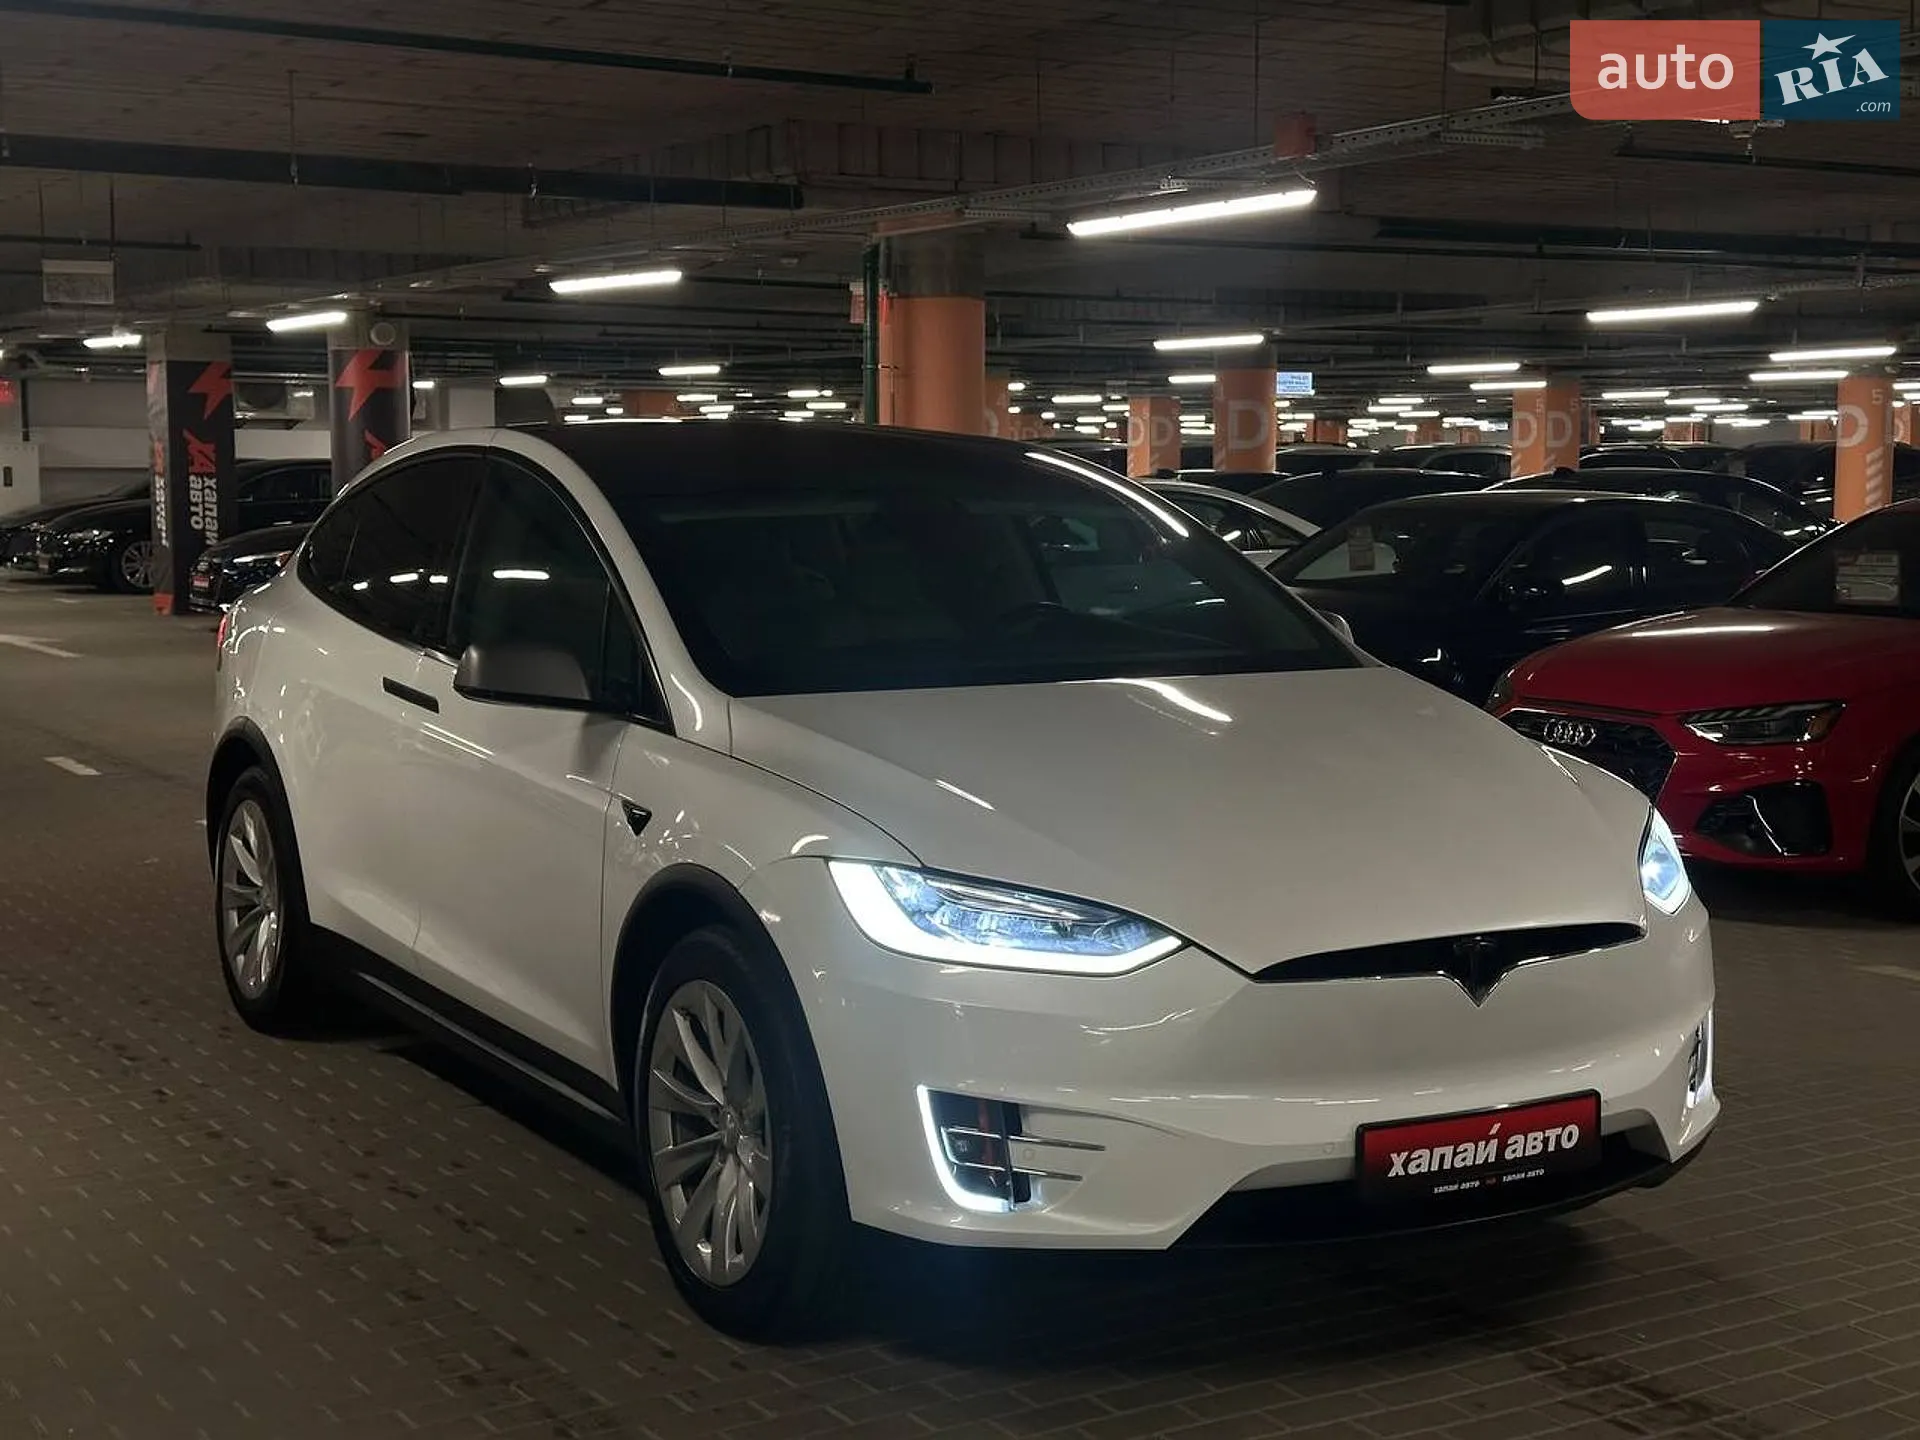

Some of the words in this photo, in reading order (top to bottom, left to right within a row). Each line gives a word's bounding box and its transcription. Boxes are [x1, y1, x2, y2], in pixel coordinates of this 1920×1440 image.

[1150, 416, 1174, 448] D
[1228, 399, 1268, 450] D
[1512, 411, 1538, 448] D
[1547, 411, 1572, 448] D
[1838, 403, 1869, 448] D
[1387, 1123, 1501, 1177] хапай
[1504, 1124, 1580, 1160] авто
